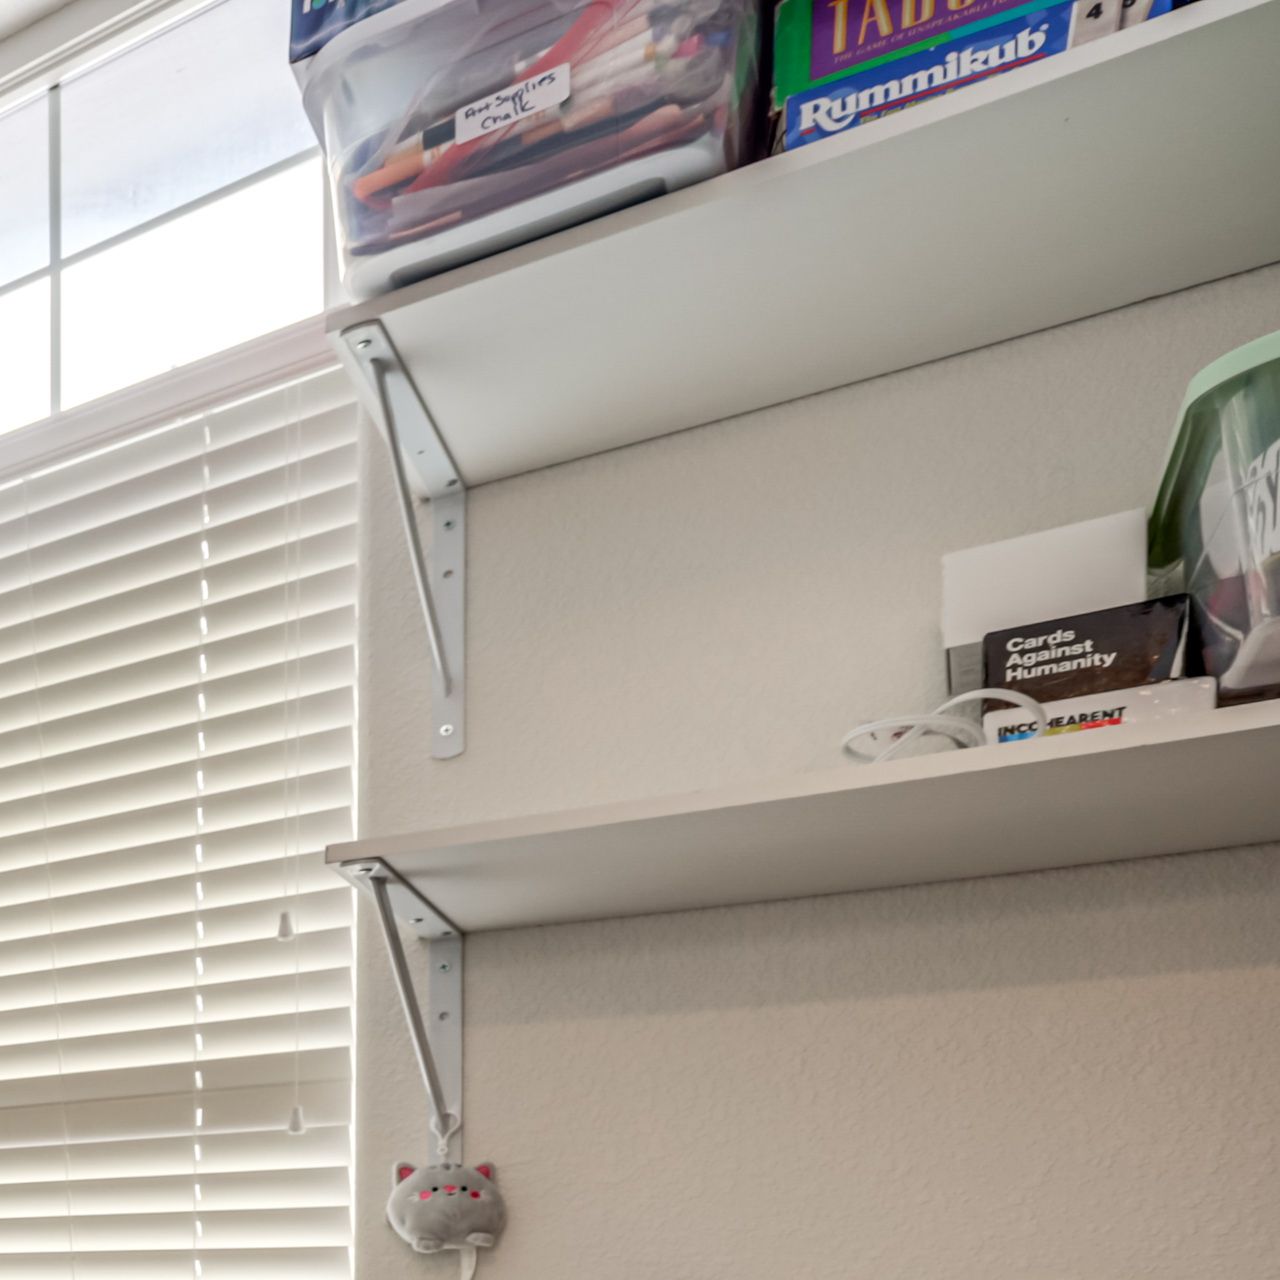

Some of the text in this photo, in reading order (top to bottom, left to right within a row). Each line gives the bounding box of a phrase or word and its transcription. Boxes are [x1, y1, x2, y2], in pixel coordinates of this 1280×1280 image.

[1086, 3, 1103, 19] 4
[800, 24, 1050, 131] Rummikub
[464, 72, 556, 119] Art Supplies
[1006, 629, 1076, 652] Cards
[1006, 639, 1093, 667] Against
[1005, 652, 1117, 682] Humanity
